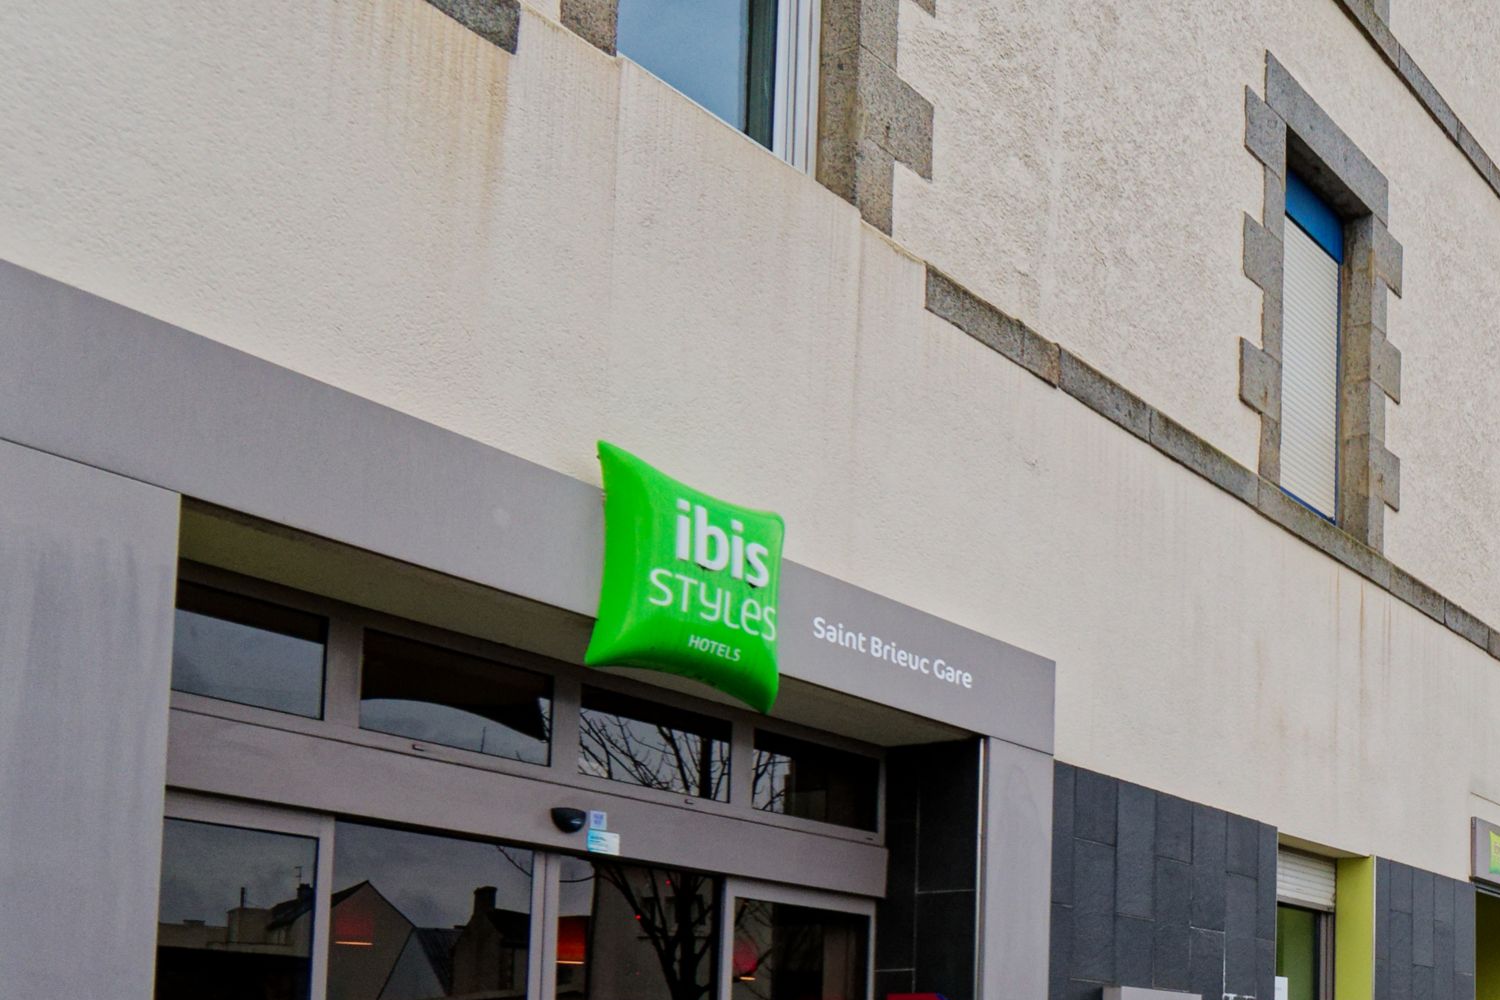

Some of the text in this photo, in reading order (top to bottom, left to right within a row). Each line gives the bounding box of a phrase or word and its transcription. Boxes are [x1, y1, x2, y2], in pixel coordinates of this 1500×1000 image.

[675, 498, 770, 588] ibis
[688, 633, 741, 662] HOTELS
[812, 616, 973, 689] Saint Brieuc Gare
